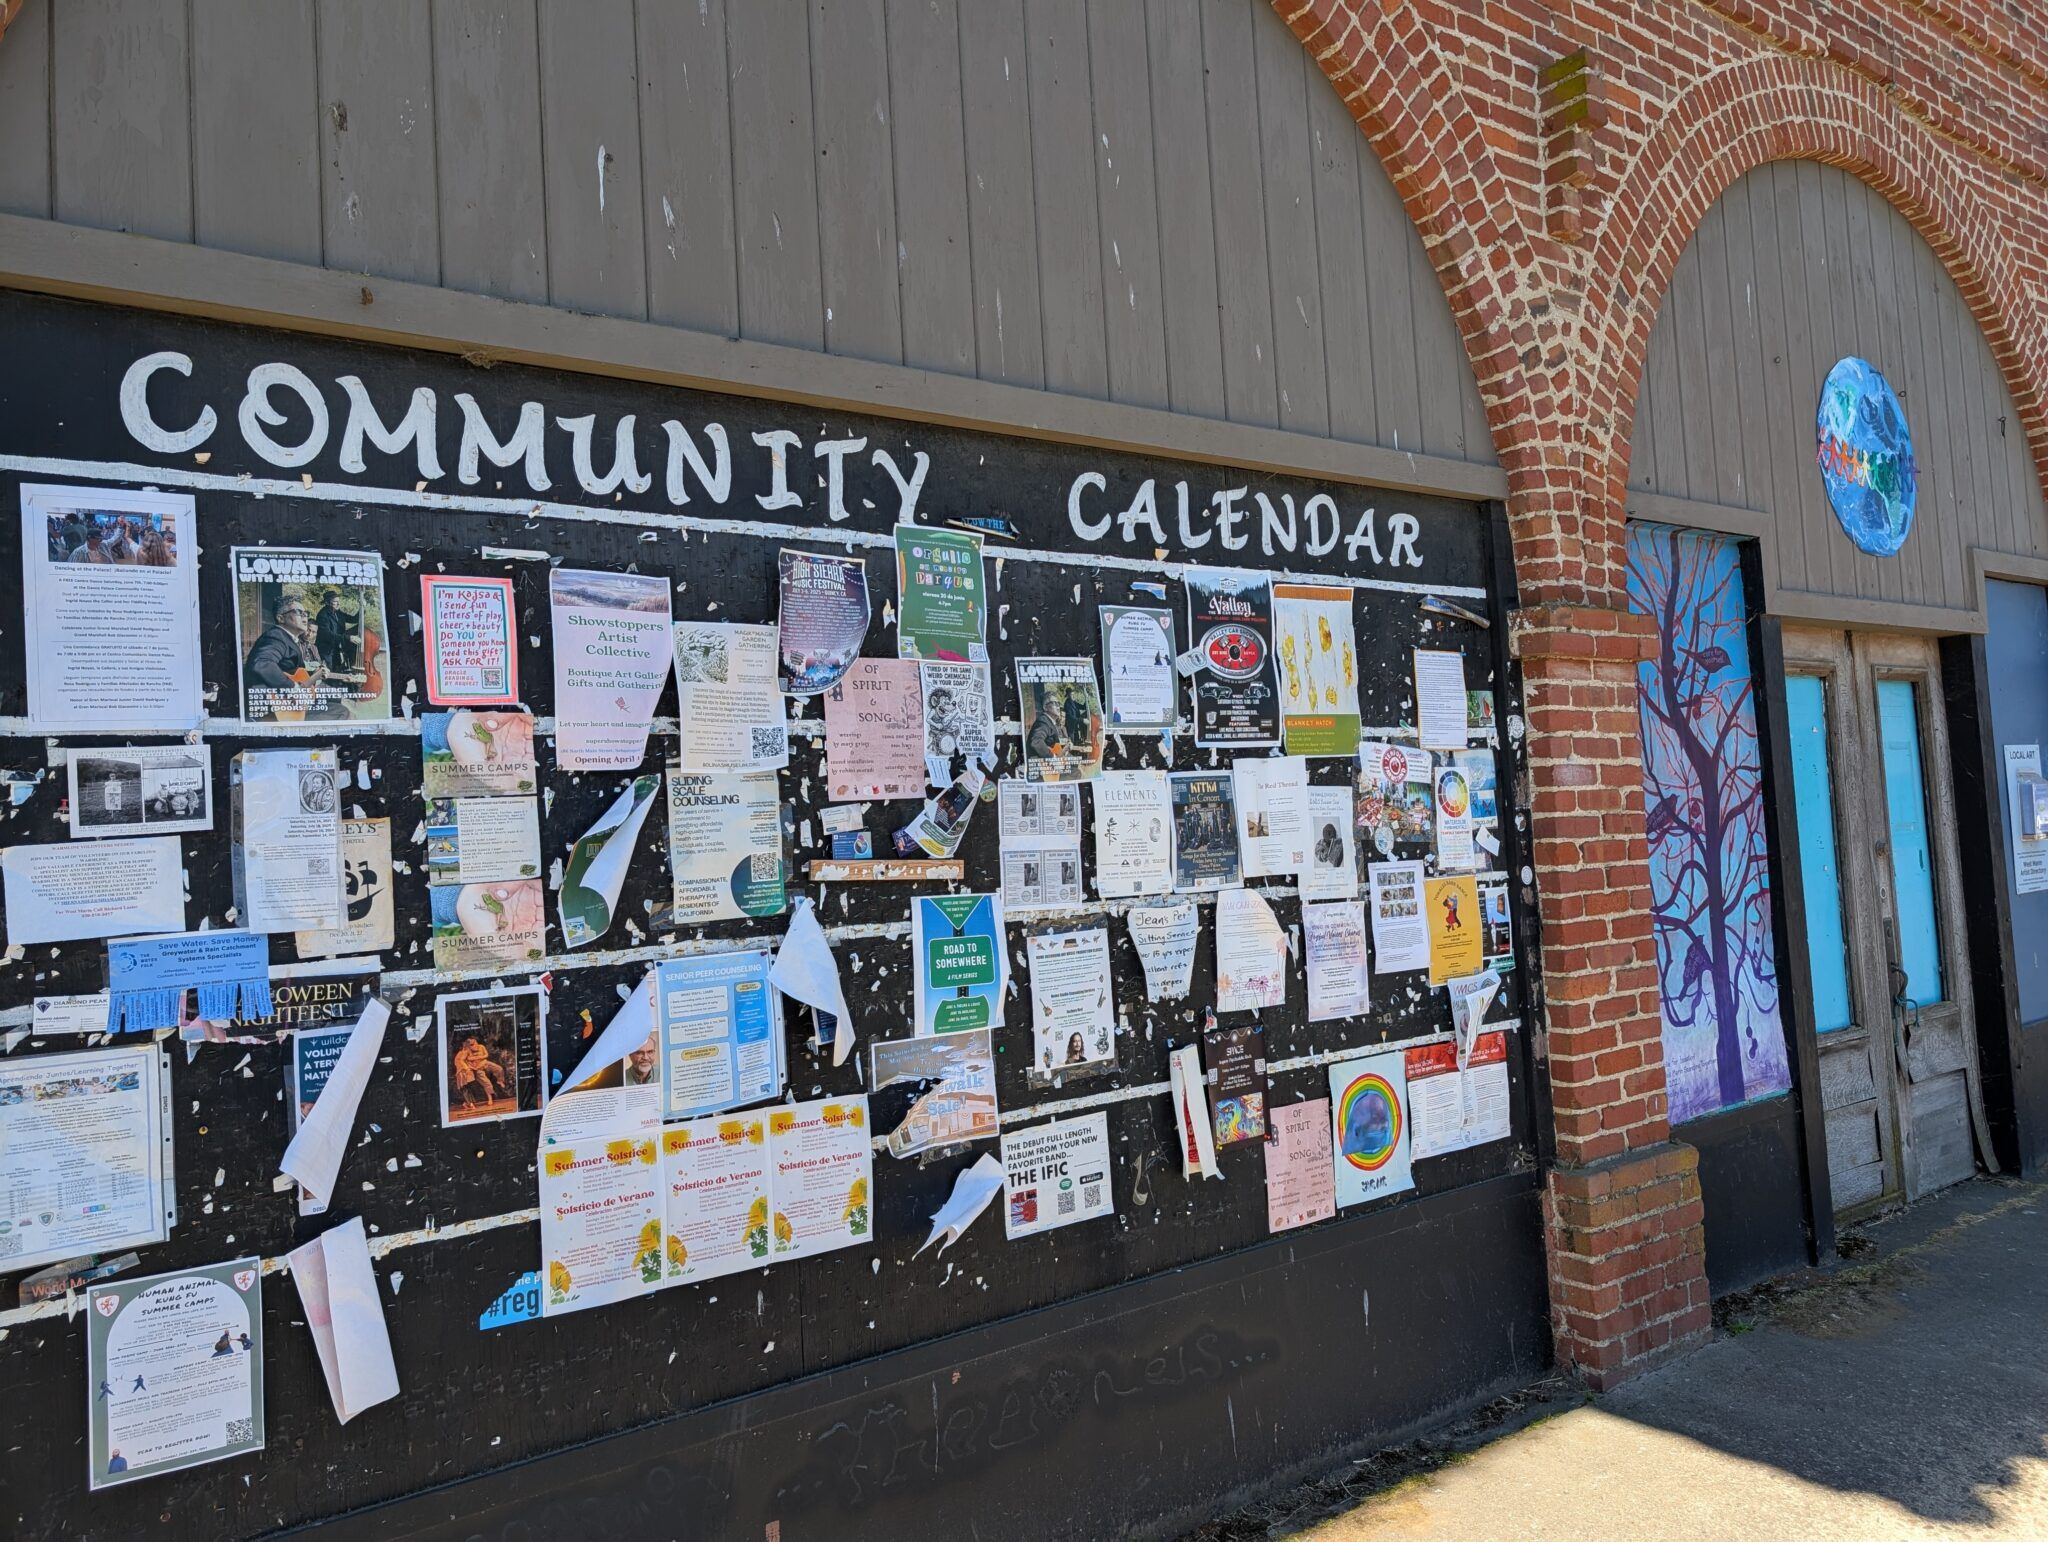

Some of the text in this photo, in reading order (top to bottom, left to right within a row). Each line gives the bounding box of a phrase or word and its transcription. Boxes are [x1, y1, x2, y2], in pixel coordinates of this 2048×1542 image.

[120, 350, 1423, 568] COMMUNITY CALENDAR
[239, 558, 377, 577] LOWATTERS
[793, 560, 845, 584] HIGH SIERRA
[239, 574, 379, 586] WITH JACOB AND SARA
[792, 579, 846, 591] MUSIC FESTIVAL
[438, 590, 502, 602] I'm Kajsa &
[1209, 595, 1251, 618] Valley
[568, 615, 664, 632] Showstoppers
[598, 631, 638, 643] Artist
[586, 645, 651, 658] Collective
[487, 657, 499, 665] IT!
[568, 668, 612, 678] Boutique
[615, 670, 632, 678] Art
[864, 665, 879, 674] OF
[1019, 665, 1092, 677] LOWATTERS
[567, 679, 594, 687] Gifts
[852, 680, 892, 691] SPIRIT
[859, 713, 892, 722] SONG
[2010, 751, 2035, 760] LOCAL ART
[432, 763, 528, 774] SUMMER CAMPS
[672, 775, 713, 787] SLIDING
[1279, 780, 1299, 788] Thread
[672, 786, 706, 797] SCALE
[1105, 789, 1157, 801] ELEMENTS
[673, 795, 740, 807] COUNSELING
[1197, 793, 1221, 803] Concert
[2020, 867, 2047, 876] Artist Directory
[678, 886, 717, 894] AFFORDABLE
[679, 894, 705, 902] THERAPY
[678, 902, 710, 910] RESIDENTS
[678, 909, 714, 918] CALIFORNIA
[1136, 911, 1169, 927] Jean's
[181, 940, 209, 948] Water.
[211, 938, 230, 947] Save
[233, 935, 262, 945] Money.
[441, 931, 538, 948] SUMMER CAMPS
[1138, 929, 1197, 946] Sitting Service
[944, 943, 977, 955] ROAD TO
[177, 952, 242, 963] Systems Specialists
[935, 955, 987, 968] SOMEWHERE
[665, 964, 762, 982] SENIOR PEER COUNSELING
[107, 1062, 139, 1071] Together
[1292, 1109, 1302, 1118] OF
[641, 1118, 660, 1126] MARIN
[777, 1112, 857, 1131] Summer Solstice
[1286, 1121, 1311, 1134] SPIRIT
[670, 1129, 755, 1150] Summer Solstice
[1007, 1127, 1092, 1152] THE DEBUT FULL LENGTH
[1008, 1135, 1099, 1161] ALBUM FROM YOUR NEW
[554, 1148, 648, 1172] Summer Solstice
[778, 1151, 863, 1171] Solsticio de Verano
[1290, 1149, 1312, 1161] SONG
[1008, 1157, 1043, 1171] FAVORITE
[1009, 1161, 1068, 1187] THE IFIC
[673, 1169, 762, 1193] Solsticio de Verano
[557, 1190, 655, 1216] Solsticio de Verano
[138, 1279, 218, 1299] HUMAN ANIMAL
[155, 1291, 197, 1304] KUNG FU
[488, 1289, 539, 1317] #reg
[141, 1296, 215, 1315] SUMMER CAMPS
